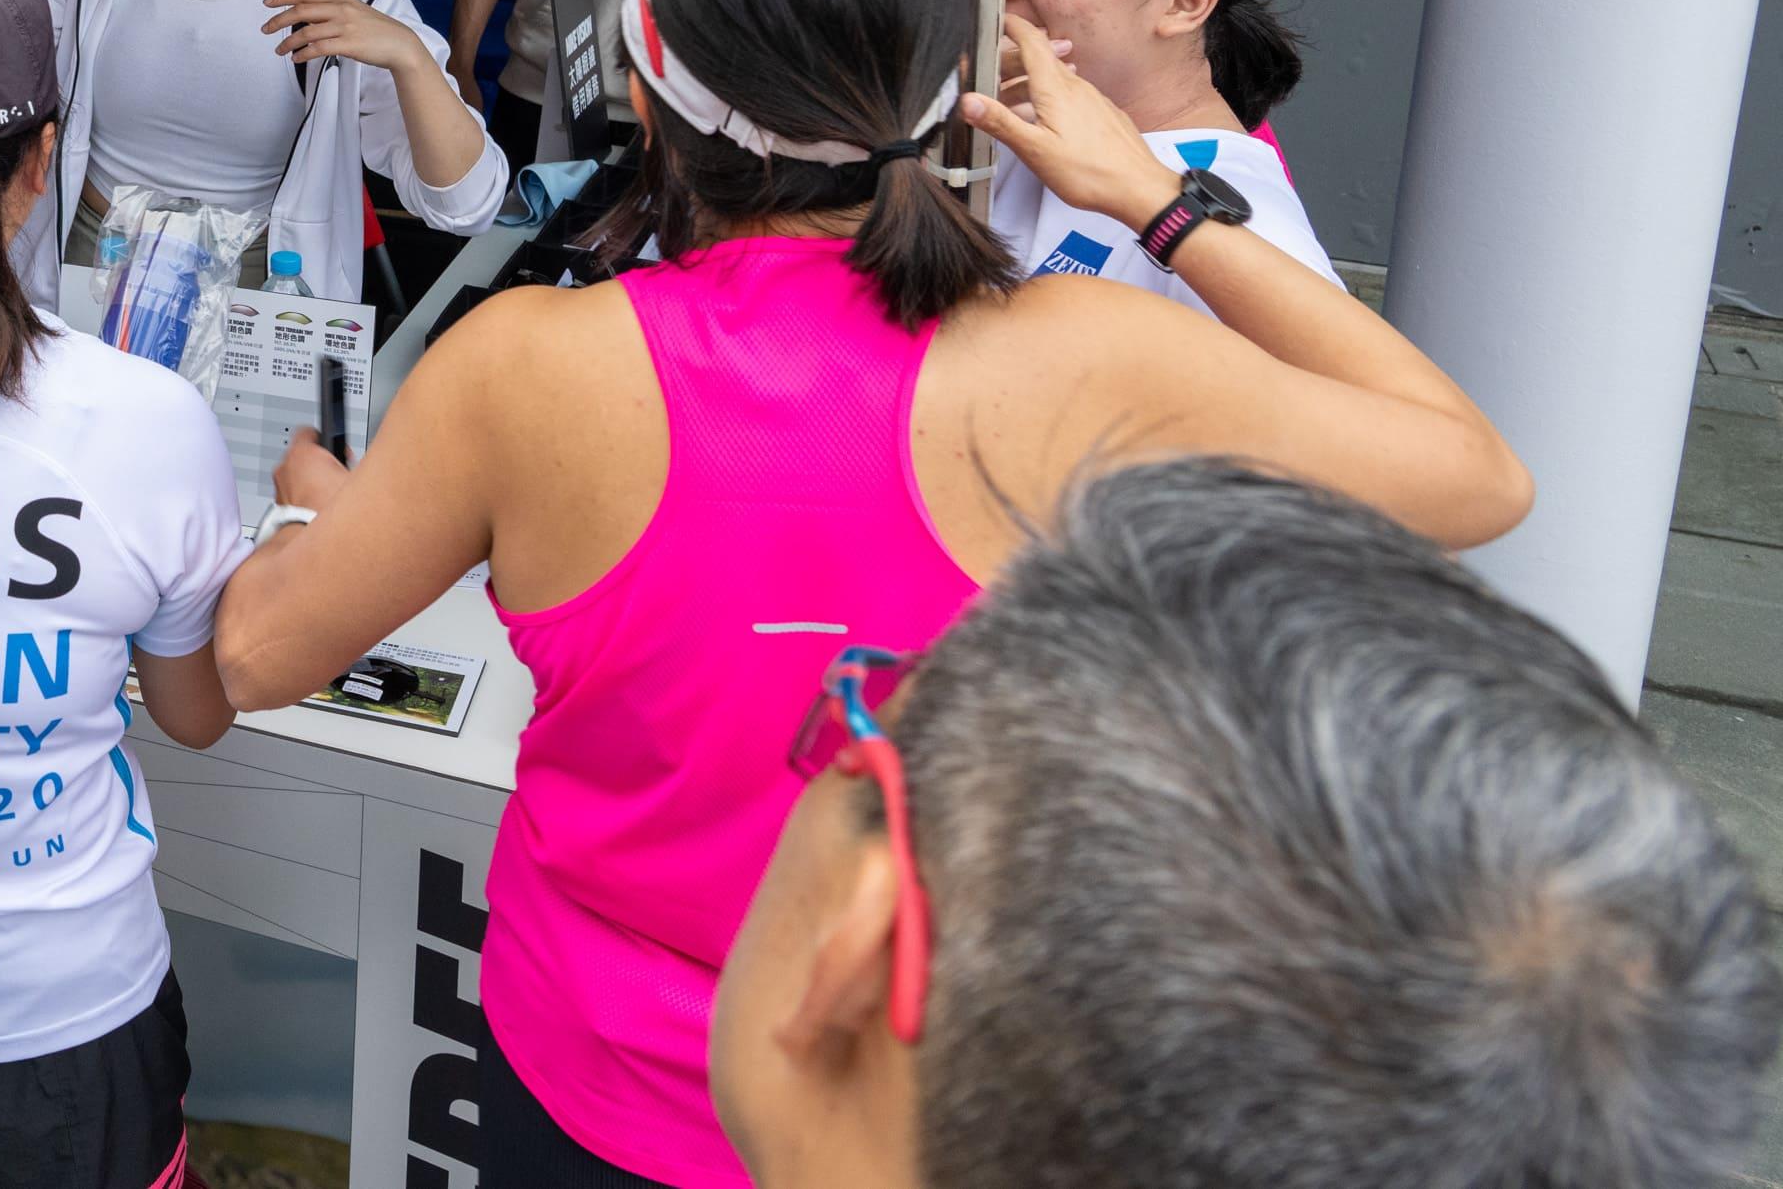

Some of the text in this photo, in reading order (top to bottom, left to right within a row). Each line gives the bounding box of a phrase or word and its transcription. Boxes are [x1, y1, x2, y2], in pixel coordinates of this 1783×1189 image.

[227, 325, 253, 336] 路色調
[275, 332, 305, 343] 地形色調
